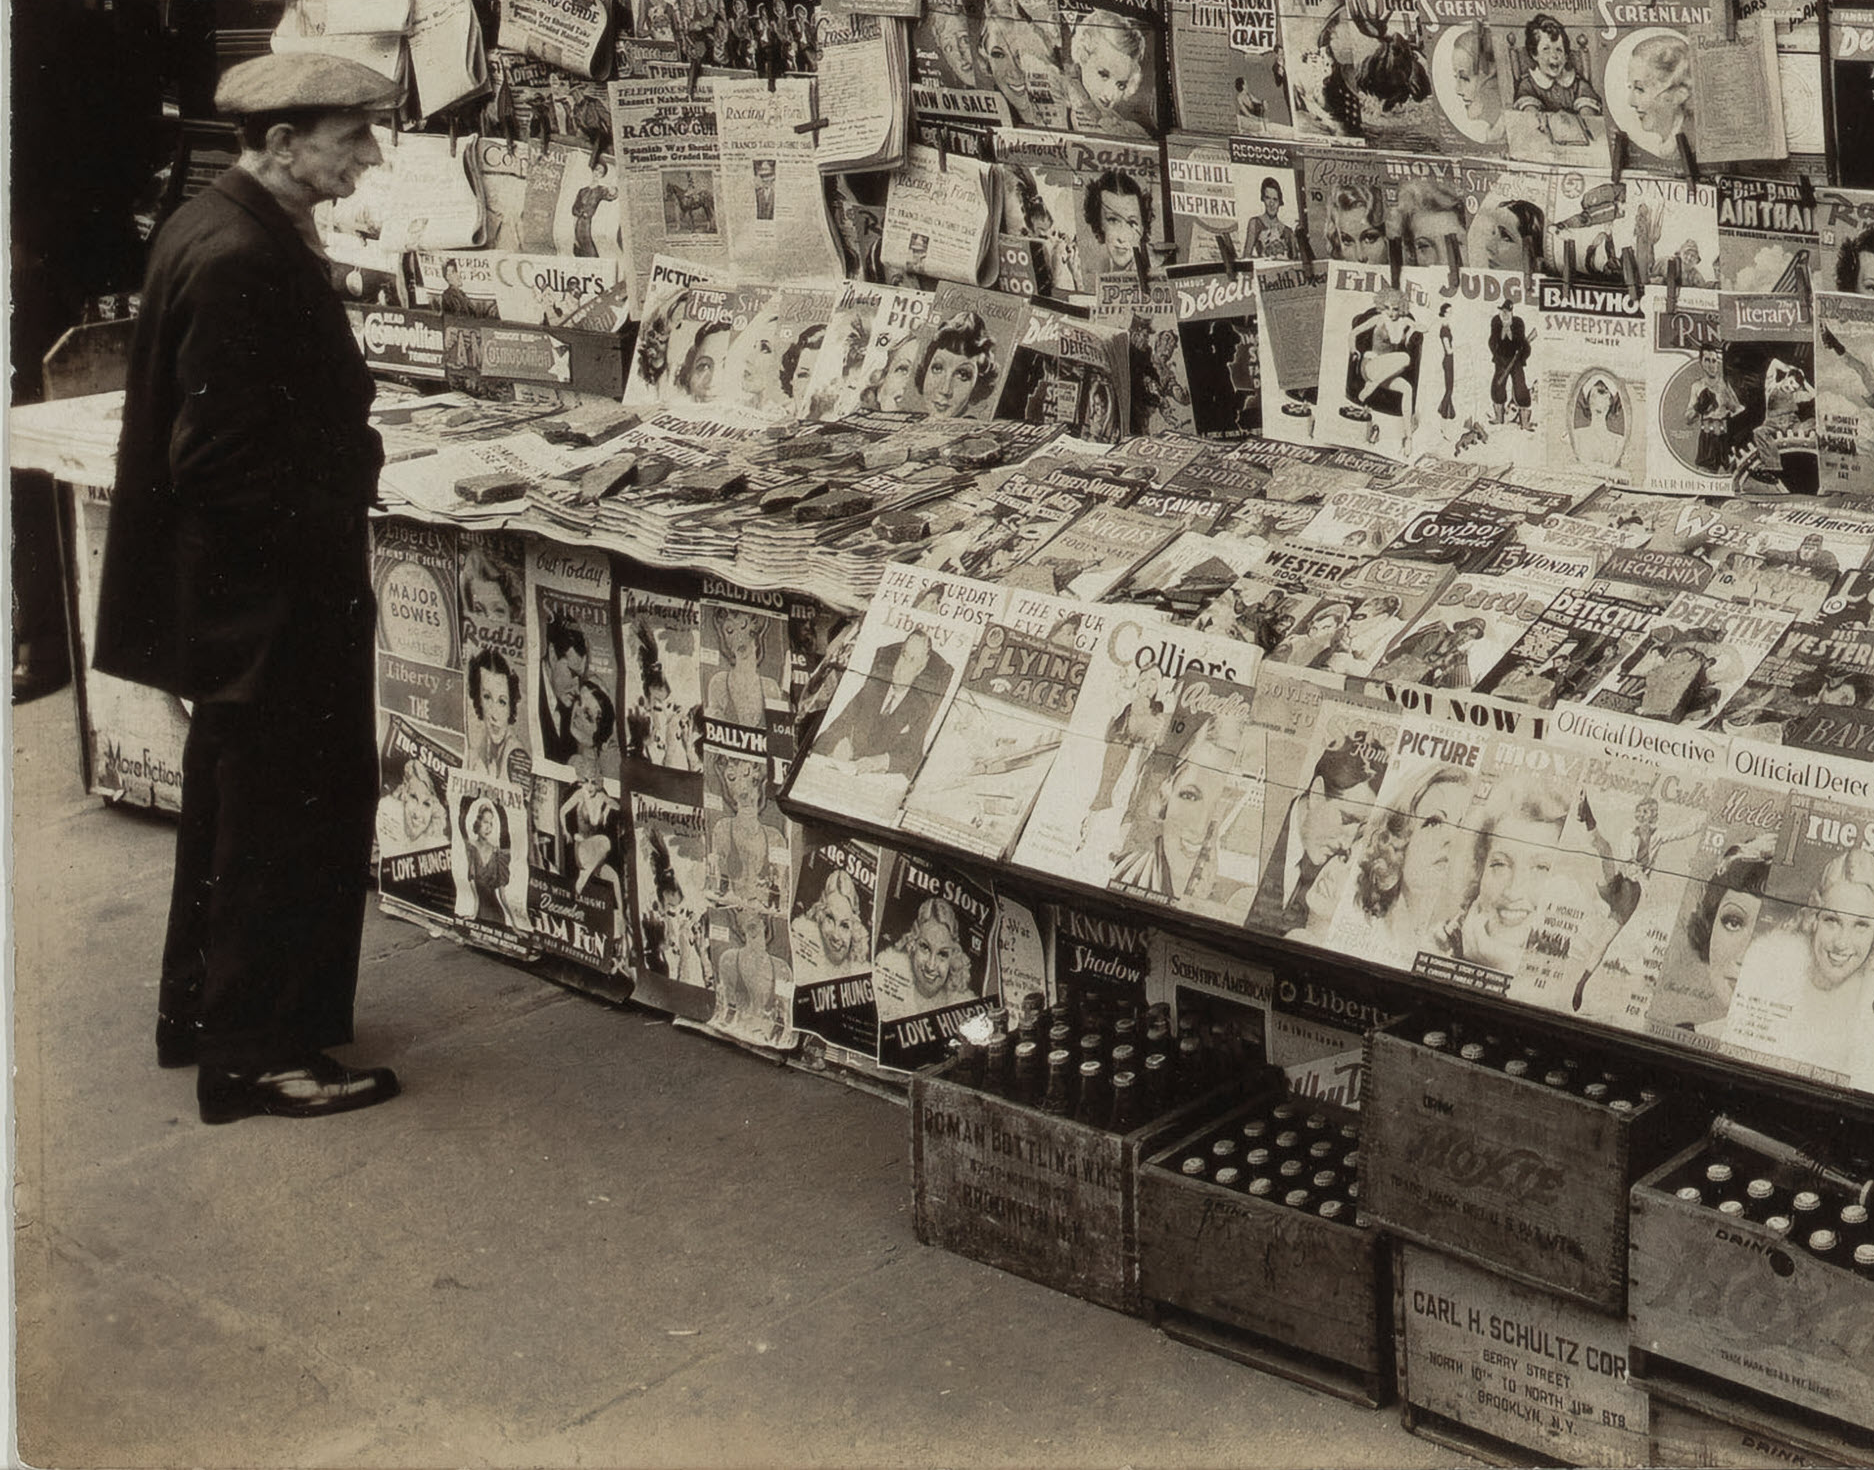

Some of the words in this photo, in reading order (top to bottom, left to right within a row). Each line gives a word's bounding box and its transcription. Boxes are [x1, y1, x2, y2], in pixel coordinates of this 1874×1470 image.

[1230, 11, 1274, 30] WAVE
[1232, 30, 1276, 47] CRAFT
[913, 92, 941, 110] NOW
[944, 94, 960, 111] ON
[963, 95, 998, 114] SALE!
[1521, 550, 1590, 579] WONDER
[1608, 557, 1706, 587] MECHANIX
[1634, 549, 1696, 568] MODERN
[387, 582, 439, 608] MAJOR
[390, 602, 442, 627] BOWES
[969, 640, 1084, 685] FLYING
[1106, 620, 1238, 685] Collier's
[385, 660, 440, 693] Liberty
[1009, 676, 1080, 714] ACES
[1446, 700, 1522, 734] NOW
[1556, 708, 1629, 752] Official
[1628, 726, 1716, 764] Detective
[142, 747, 183, 789] Fiction
[1399, 729, 1482, 769] PICTURE
[898, 856, 942, 898] True
[945, 880, 990, 925] Story
[1069, 944, 1142, 984] Shadow
[1413, 1289, 1462, 1328] CARL
[1466, 1308, 1488, 1336] H.
[1489, 1315, 1580, 1370] SCHULTZ
[1428, 1350, 1466, 1376] NORTH
[1501, 1376, 1518, 1393] TO
[1523, 1383, 1568, 1413] NORTH
[1481, 1348, 1520, 1371] BERRY
[1526, 1364, 1572, 1390] STREET
